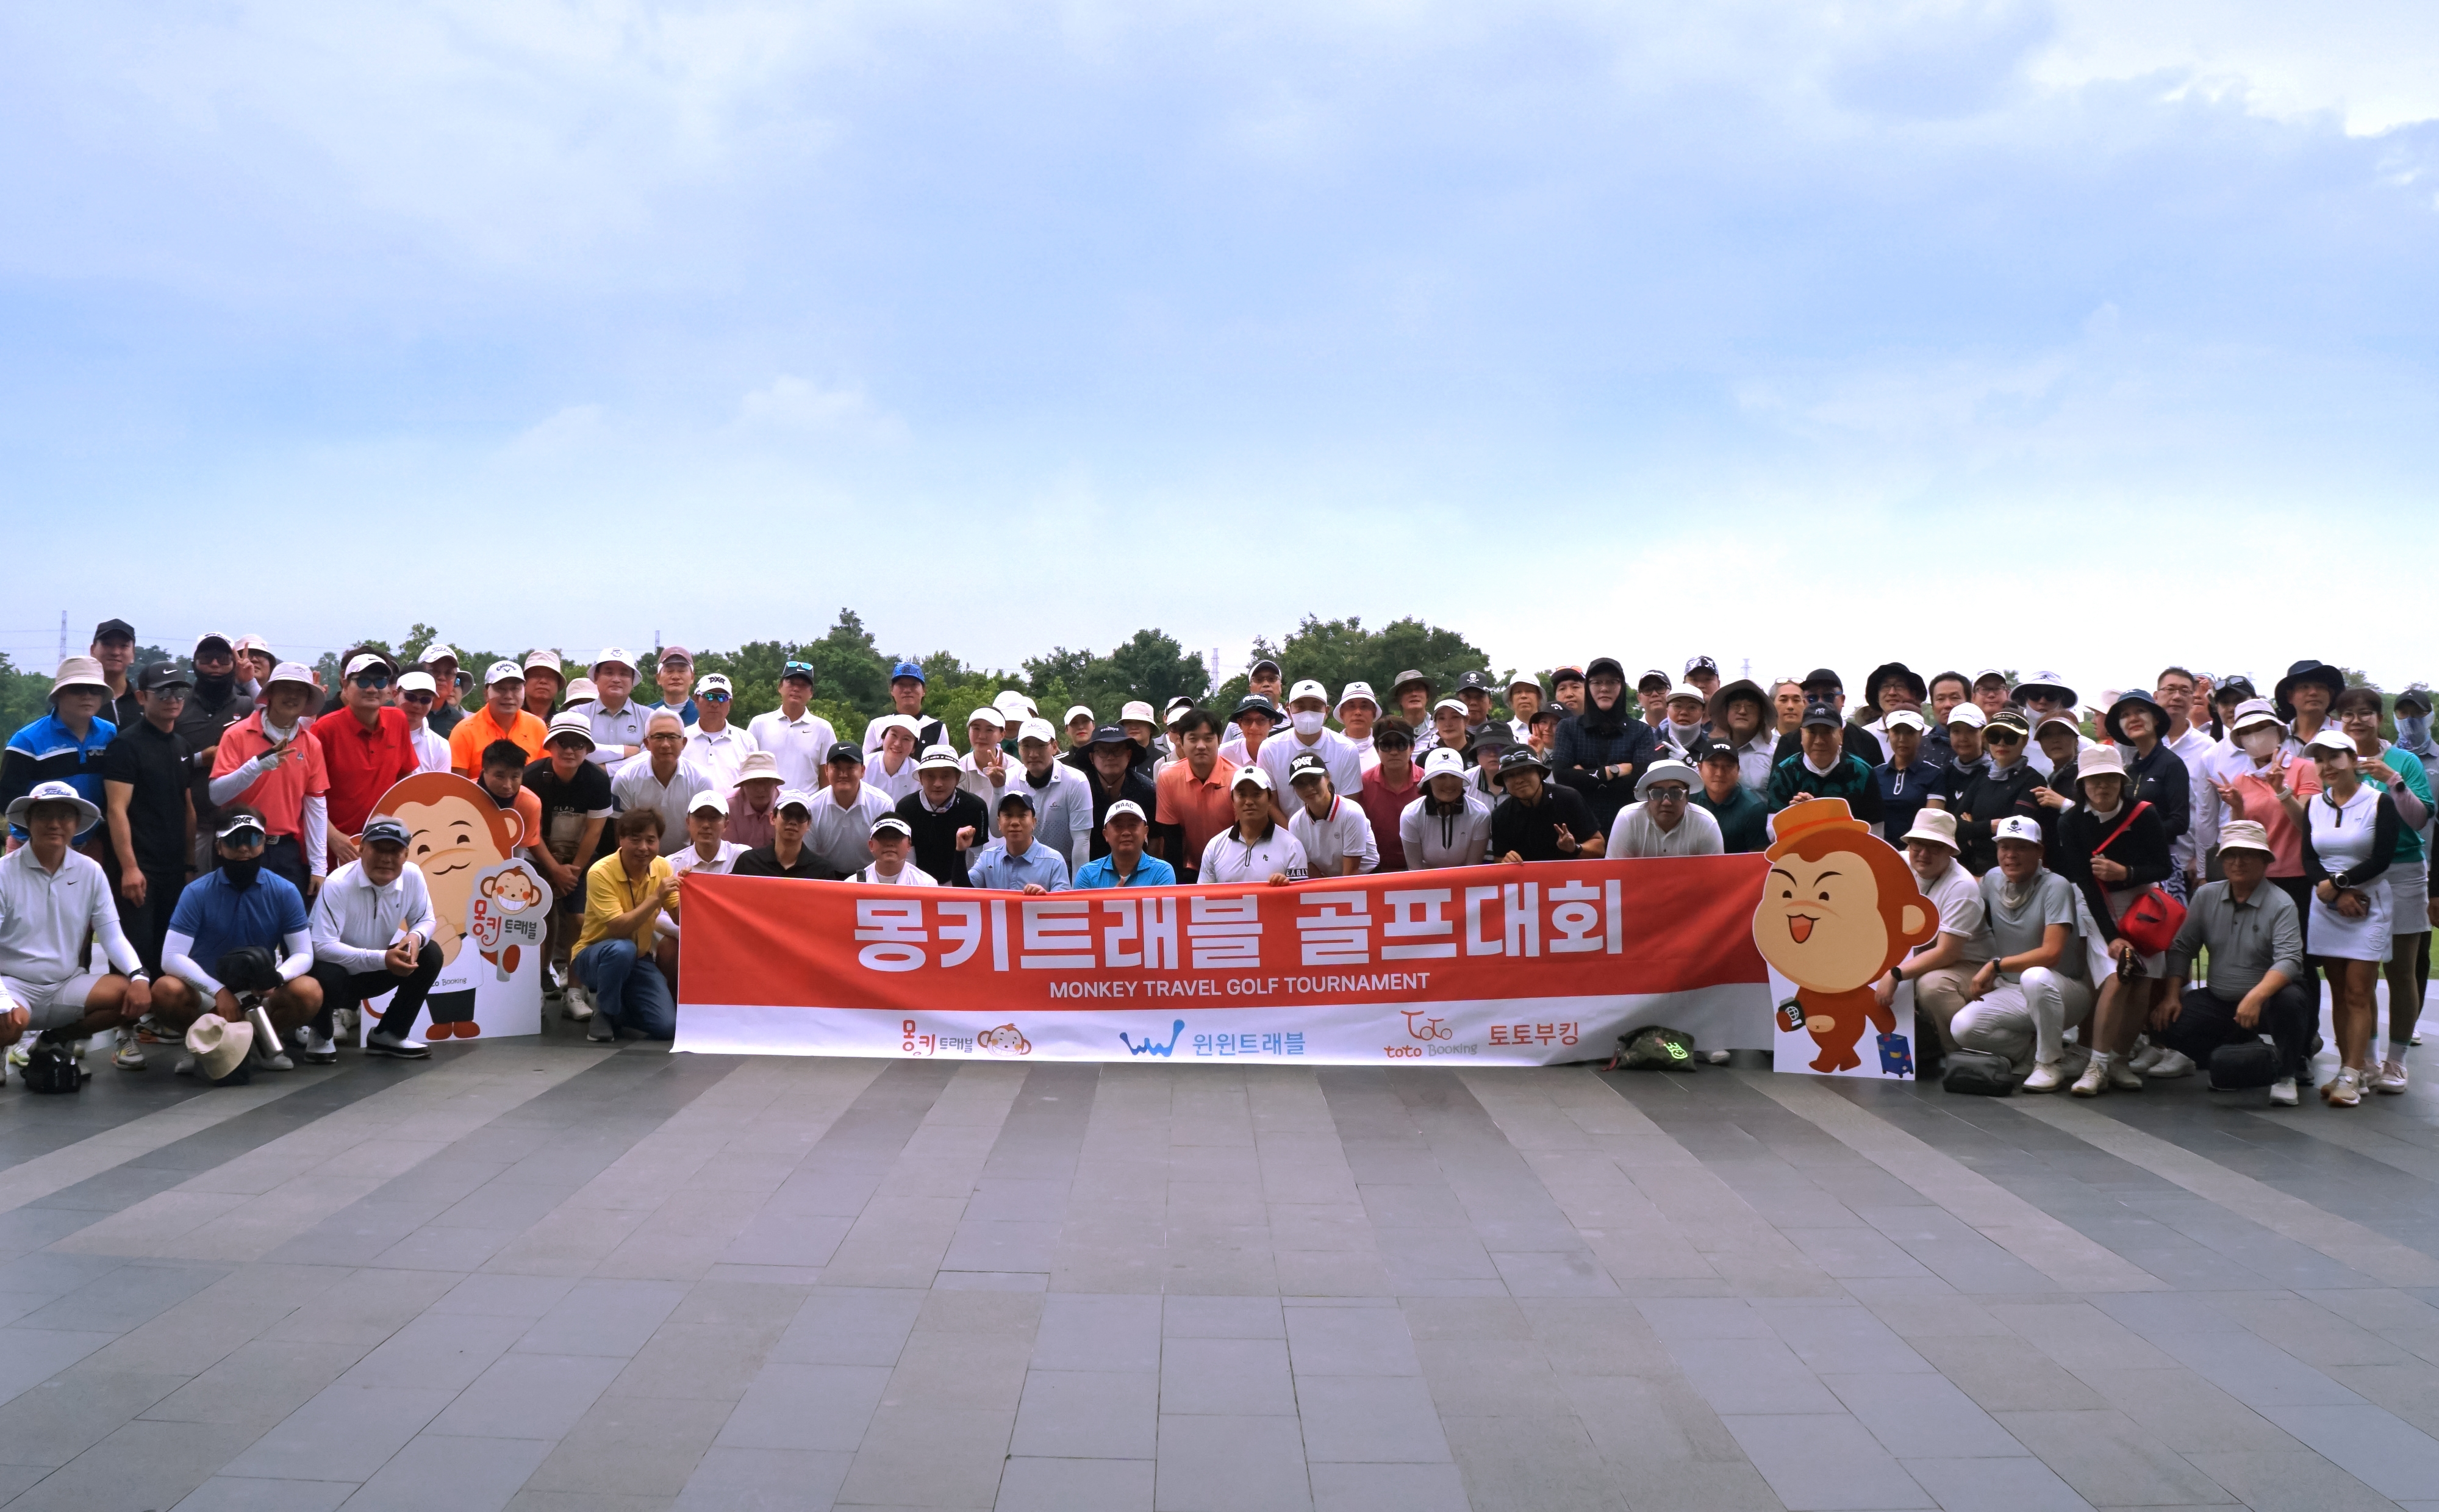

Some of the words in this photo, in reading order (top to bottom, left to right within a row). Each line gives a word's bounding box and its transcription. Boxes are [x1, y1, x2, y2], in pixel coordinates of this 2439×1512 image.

[496, 663, 517, 672] Callaway
[1115, 802, 1134, 811] WAAC
[473, 899, 502, 947] 몽키
[504, 919, 537, 940] 트래블
[854, 895, 1263, 972] 몽키트래블
[1297, 880, 1623, 966] 골프대회
[1050, 981, 1138, 998] MONKEY
[1142, 980, 1222, 997] TRAVEL
[1227, 978, 1279, 995] GOLF
[1284, 972, 1431, 993] TOURNAMENT
[902, 1019, 936, 1056] 몽키
[939, 1037, 973, 1053] 트래블
[1192, 1031, 1306, 1056] 윈윈트래블
[1488, 1022, 1578, 1046] 토토부킹
[1383, 1045, 1422, 1058] toto
